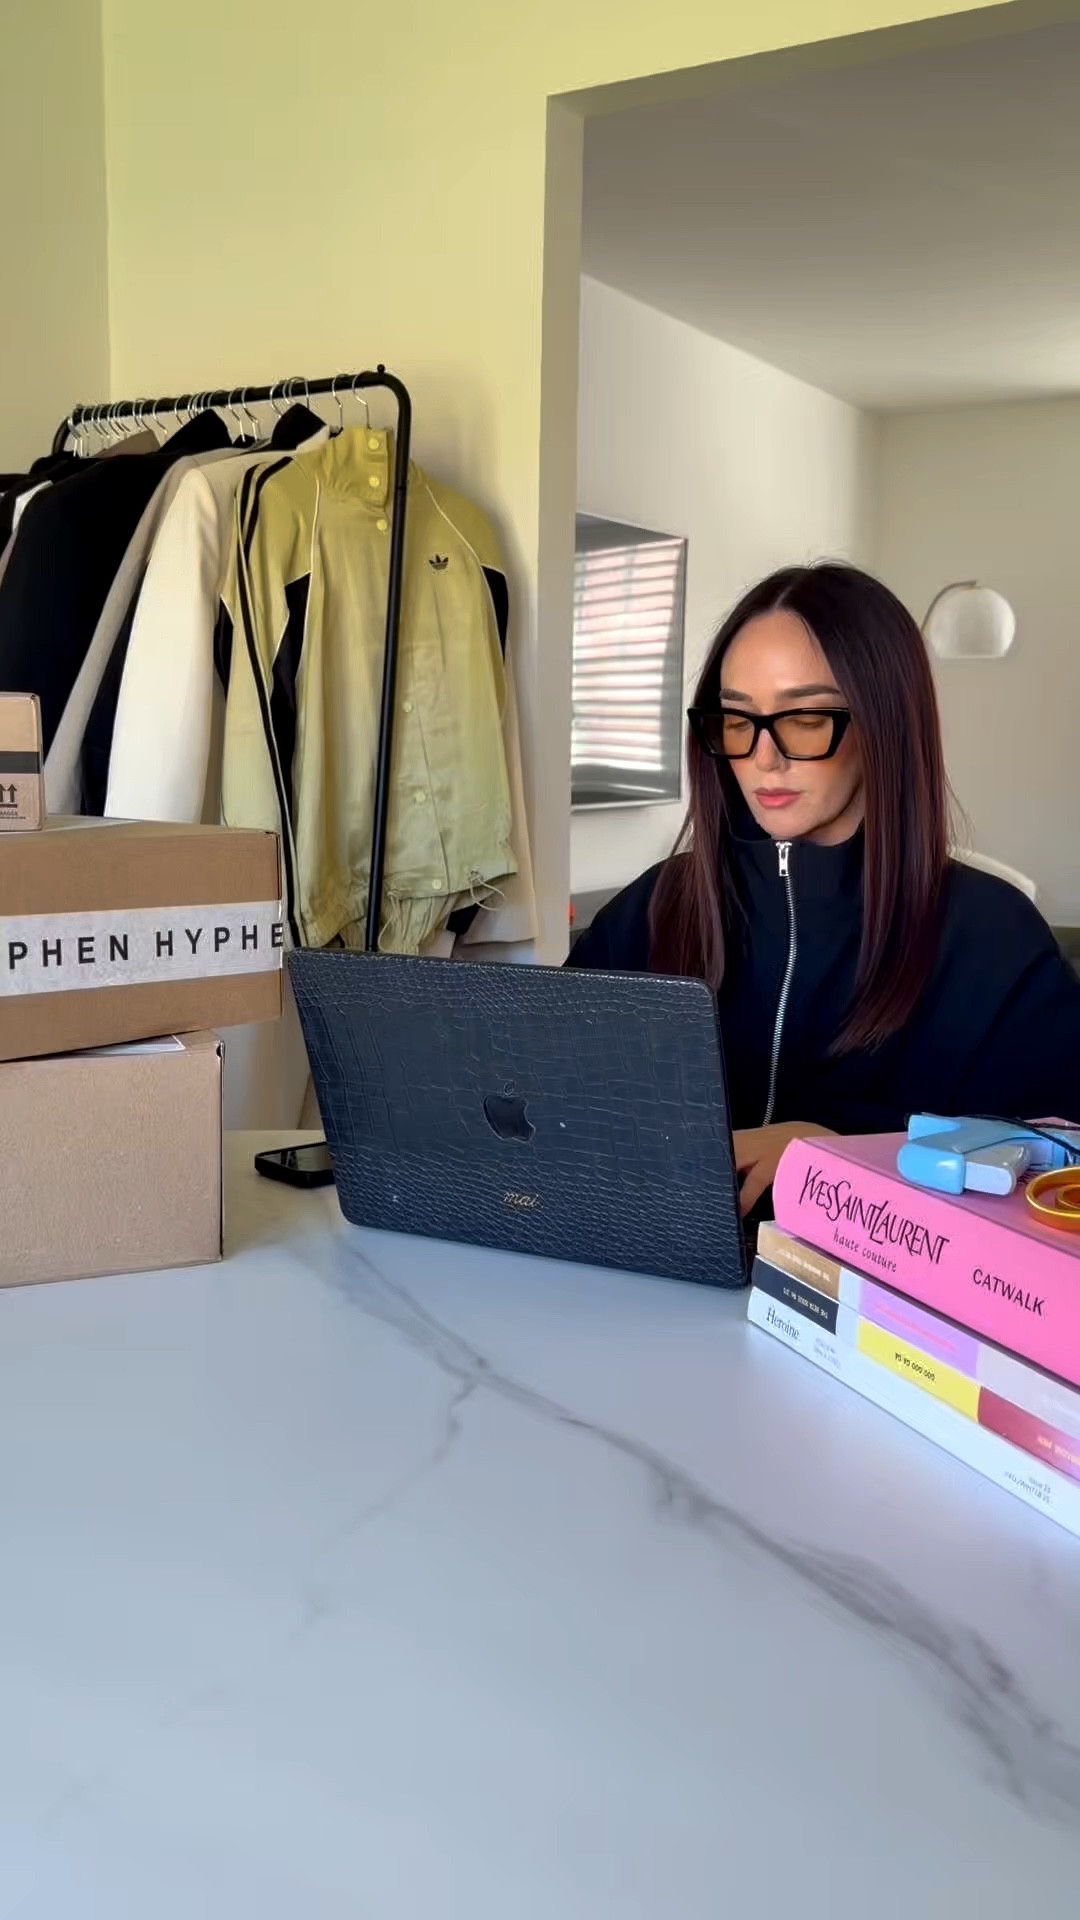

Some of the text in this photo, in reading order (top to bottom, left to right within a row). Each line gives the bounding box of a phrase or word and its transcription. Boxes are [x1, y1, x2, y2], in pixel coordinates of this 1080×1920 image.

[8, 922, 284, 970] PHEN HYPHE
[833, 1227, 859, 1253] haute
[862, 1246, 897, 1273] couture
[972, 1267, 1046, 1317] CATWALK
